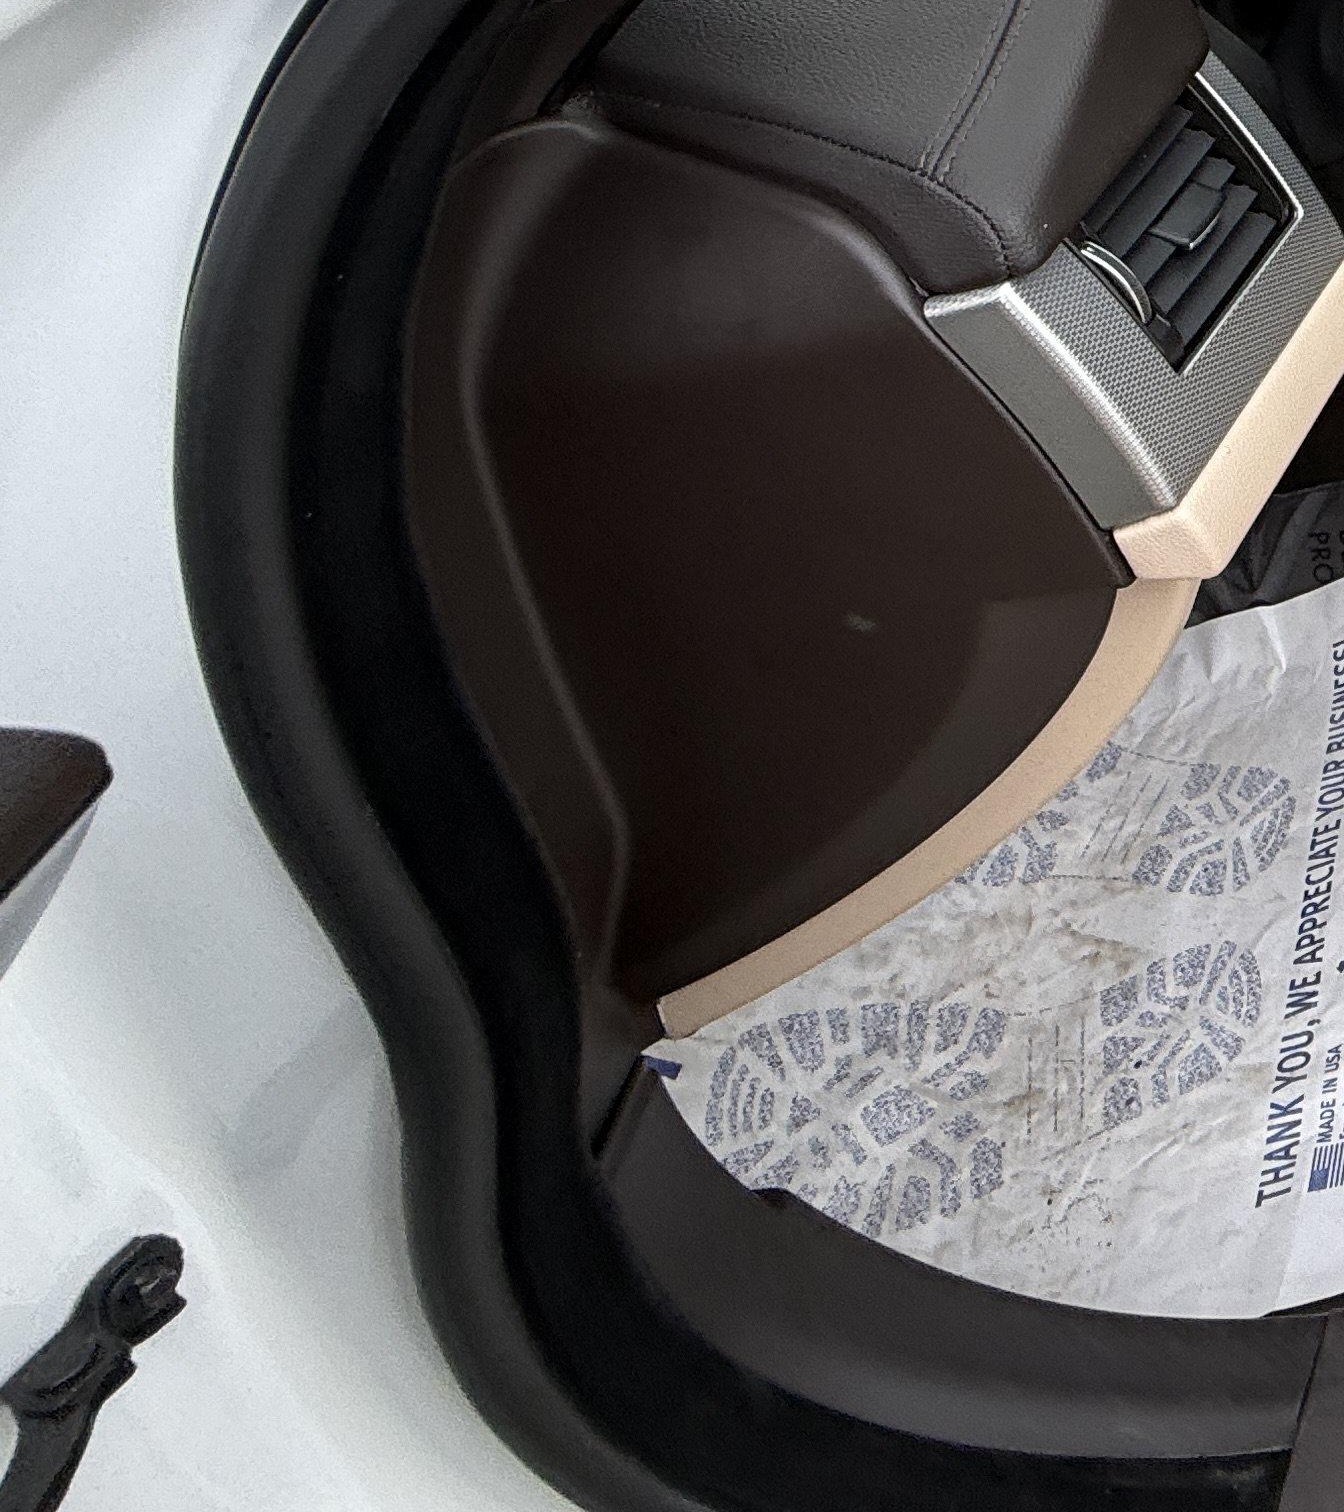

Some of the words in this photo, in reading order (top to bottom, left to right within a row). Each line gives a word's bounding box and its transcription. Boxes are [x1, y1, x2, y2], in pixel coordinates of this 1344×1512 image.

[1293, 818, 1342, 966] APPRECIATE
[1284, 970, 1323, 1020] WE
[1272, 1018, 1322, 1094] YOU,
[1325, 1043, 1343, 1075] USA
[1322, 1076, 1338, 1095] IN
[1316, 1096, 1337, 1143] MADE
[1255, 1093, 1305, 1208] THANK
